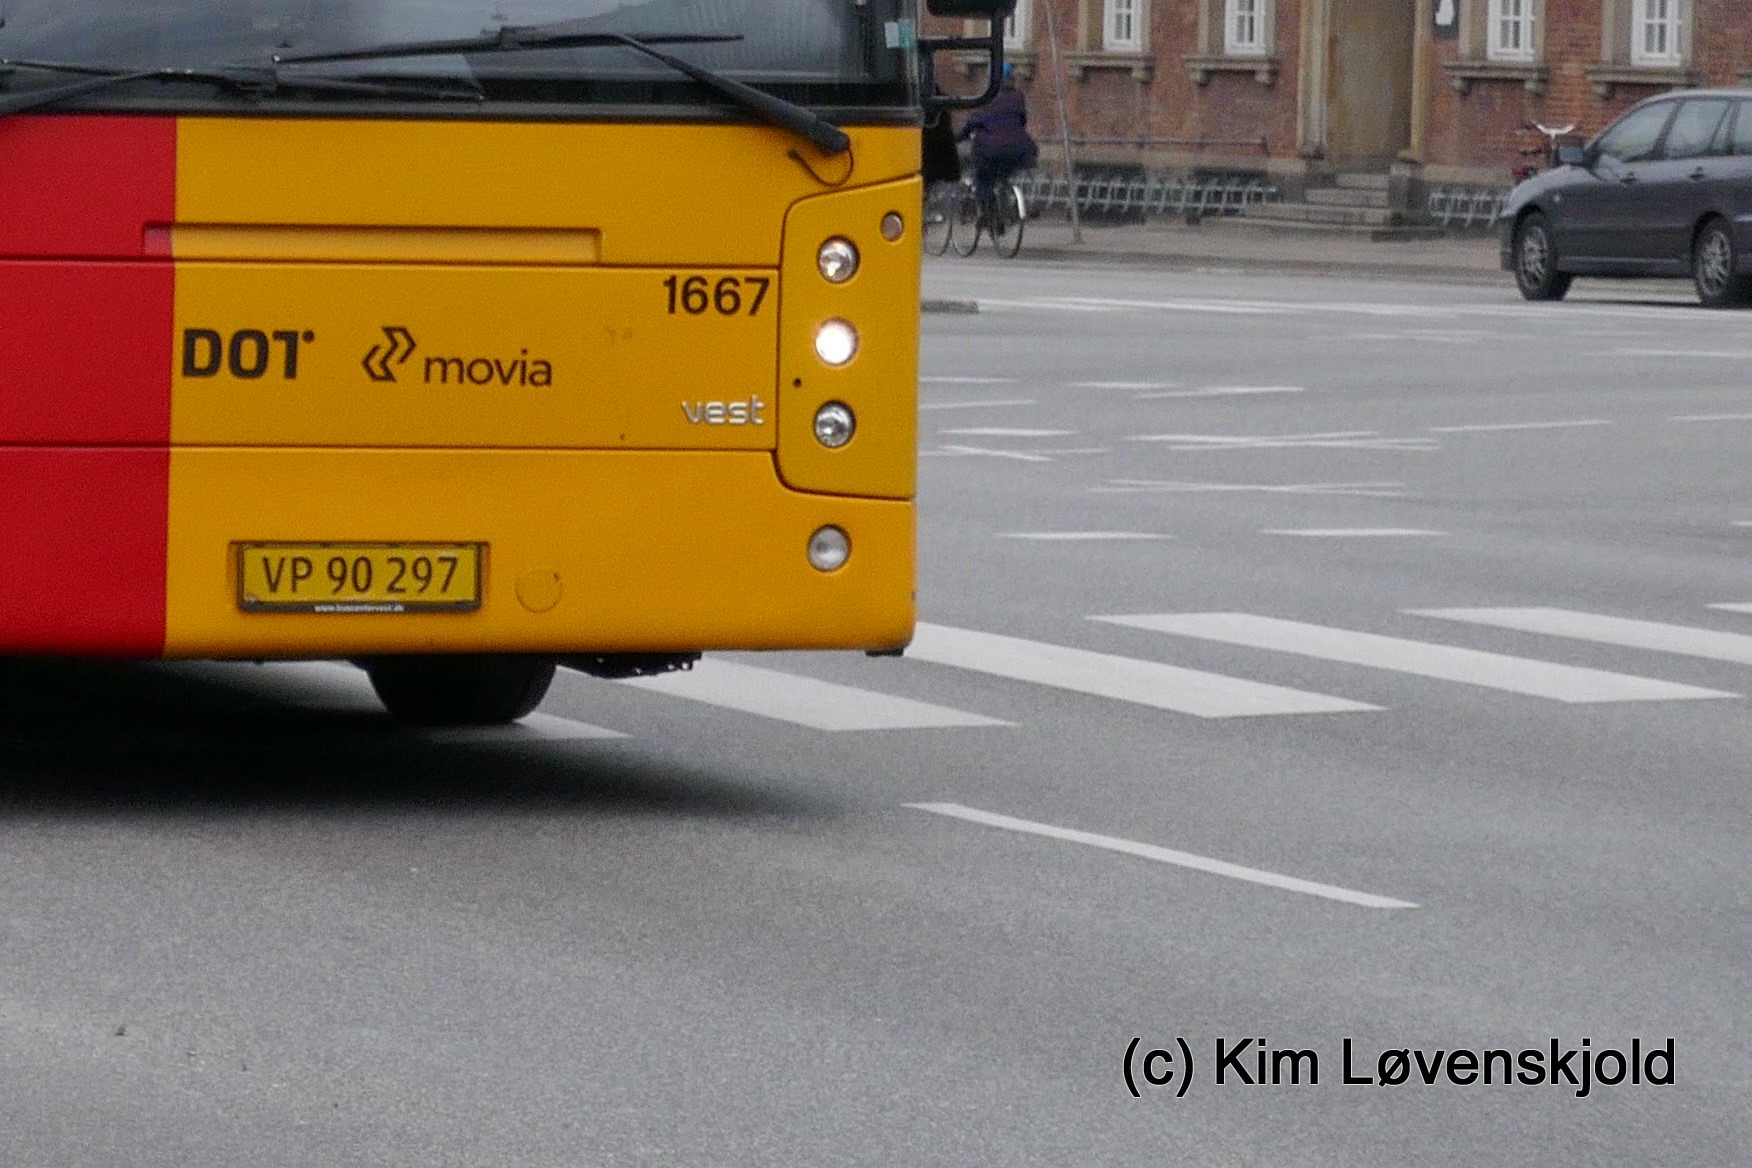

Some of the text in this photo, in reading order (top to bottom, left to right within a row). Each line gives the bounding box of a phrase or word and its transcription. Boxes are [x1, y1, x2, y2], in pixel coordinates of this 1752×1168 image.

[663, 275, 771, 317] 1667
[181, 328, 553, 387] DOT movia
[680, 393, 766, 425] vest
[262, 556, 459, 594] VP 90 297
